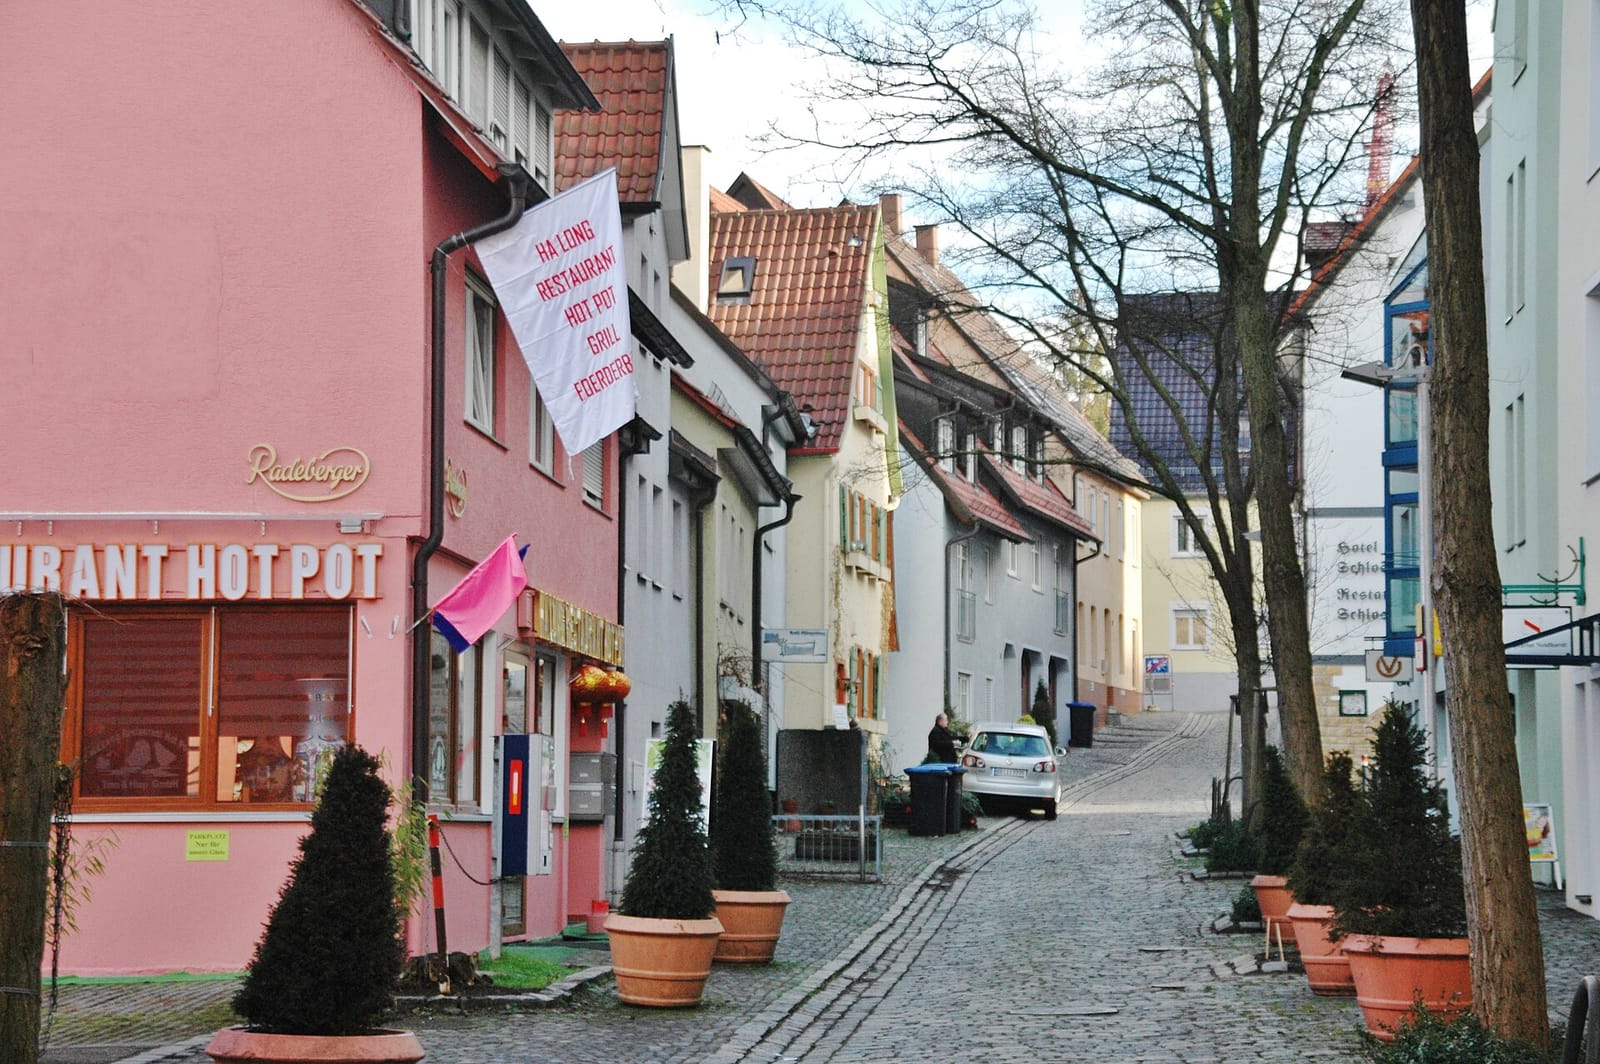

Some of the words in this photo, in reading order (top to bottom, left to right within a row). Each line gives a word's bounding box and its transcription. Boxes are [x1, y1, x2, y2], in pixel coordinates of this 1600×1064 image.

[536, 240, 558, 263] HA
[556, 220, 595, 252] LONG
[536, 245, 616, 302] RESTAURANT
[565, 299, 592, 328] HOT
[593, 286, 616, 314] POT
[587, 324, 620, 355] GRILL
[247, 443, 371, 502] Radeberger
[1337, 541, 1377, 554] Hotel
[187, 543, 280, 600] HOT
[291, 543, 384, 600] POT
